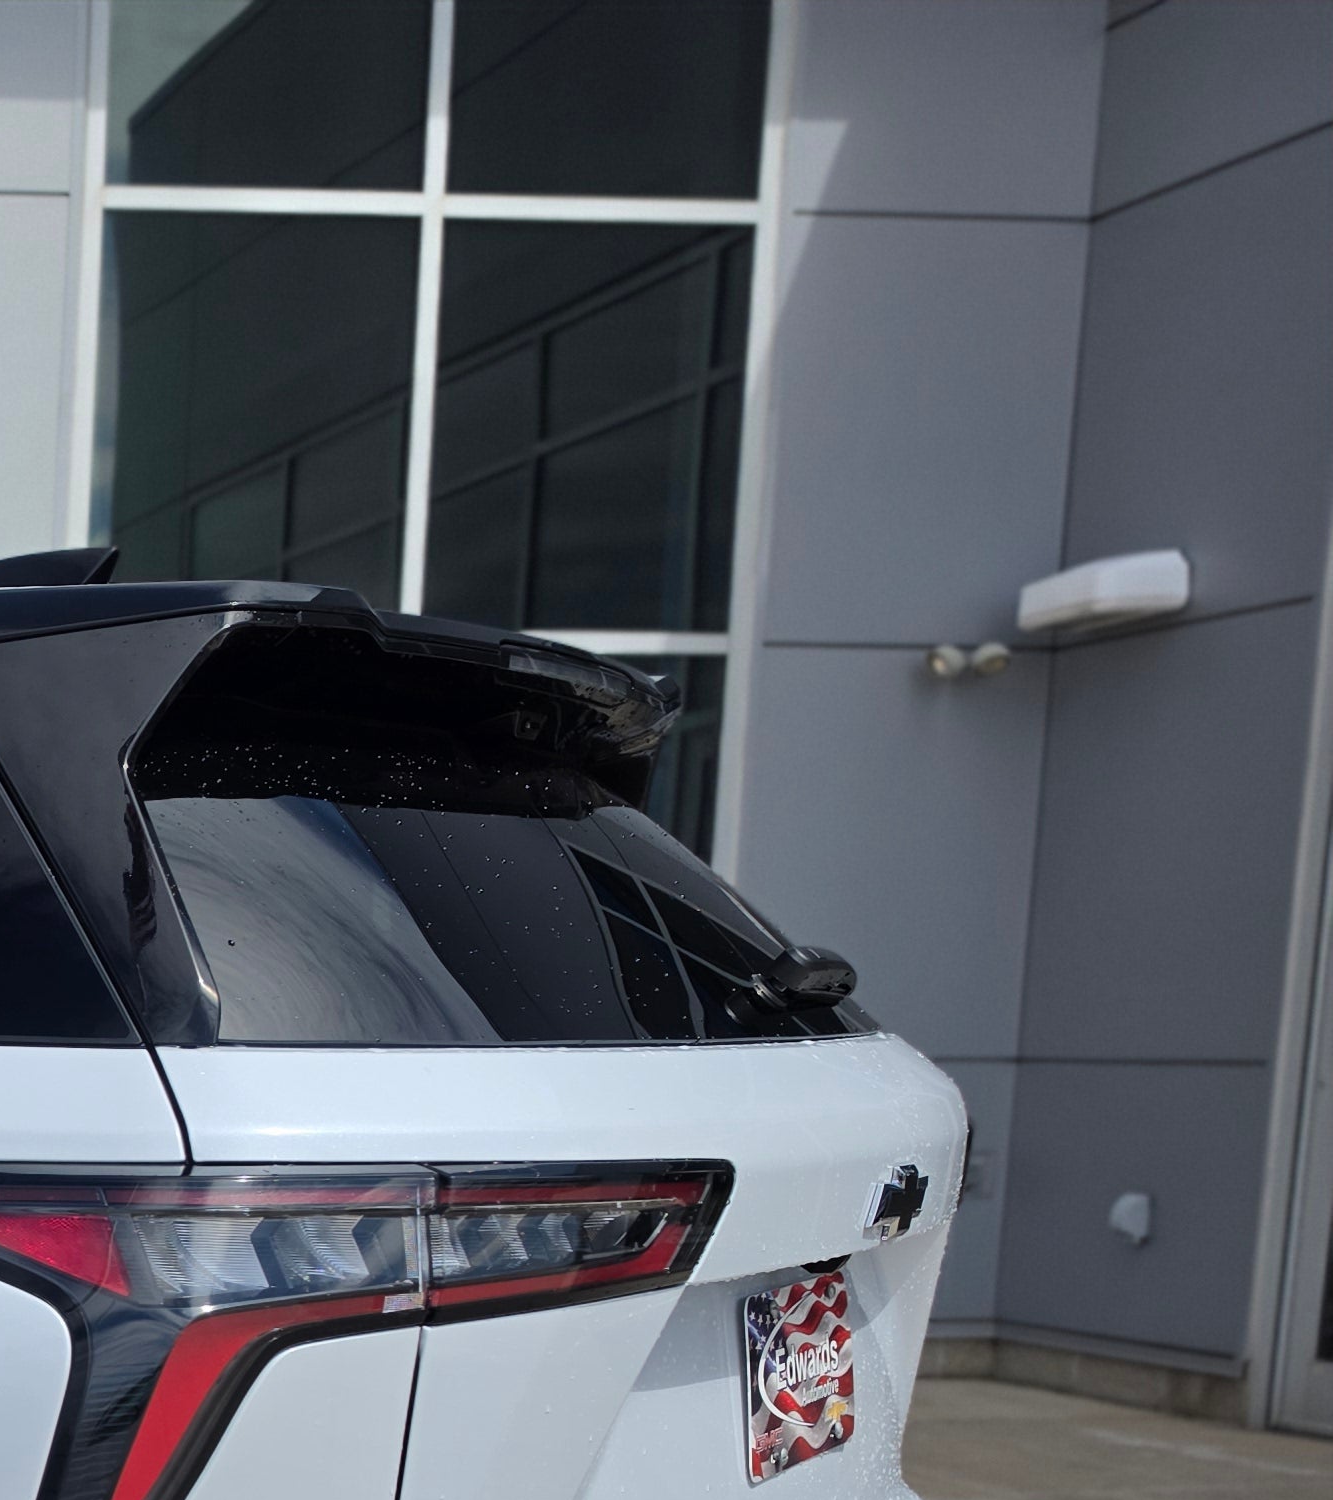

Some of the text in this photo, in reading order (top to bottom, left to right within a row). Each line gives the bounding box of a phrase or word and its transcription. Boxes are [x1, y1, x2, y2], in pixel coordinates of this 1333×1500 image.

[775, 1333, 839, 1391] Edwards
[801, 1377, 840, 1407] Automotive
[756, 1427, 784, 1453] GMC
